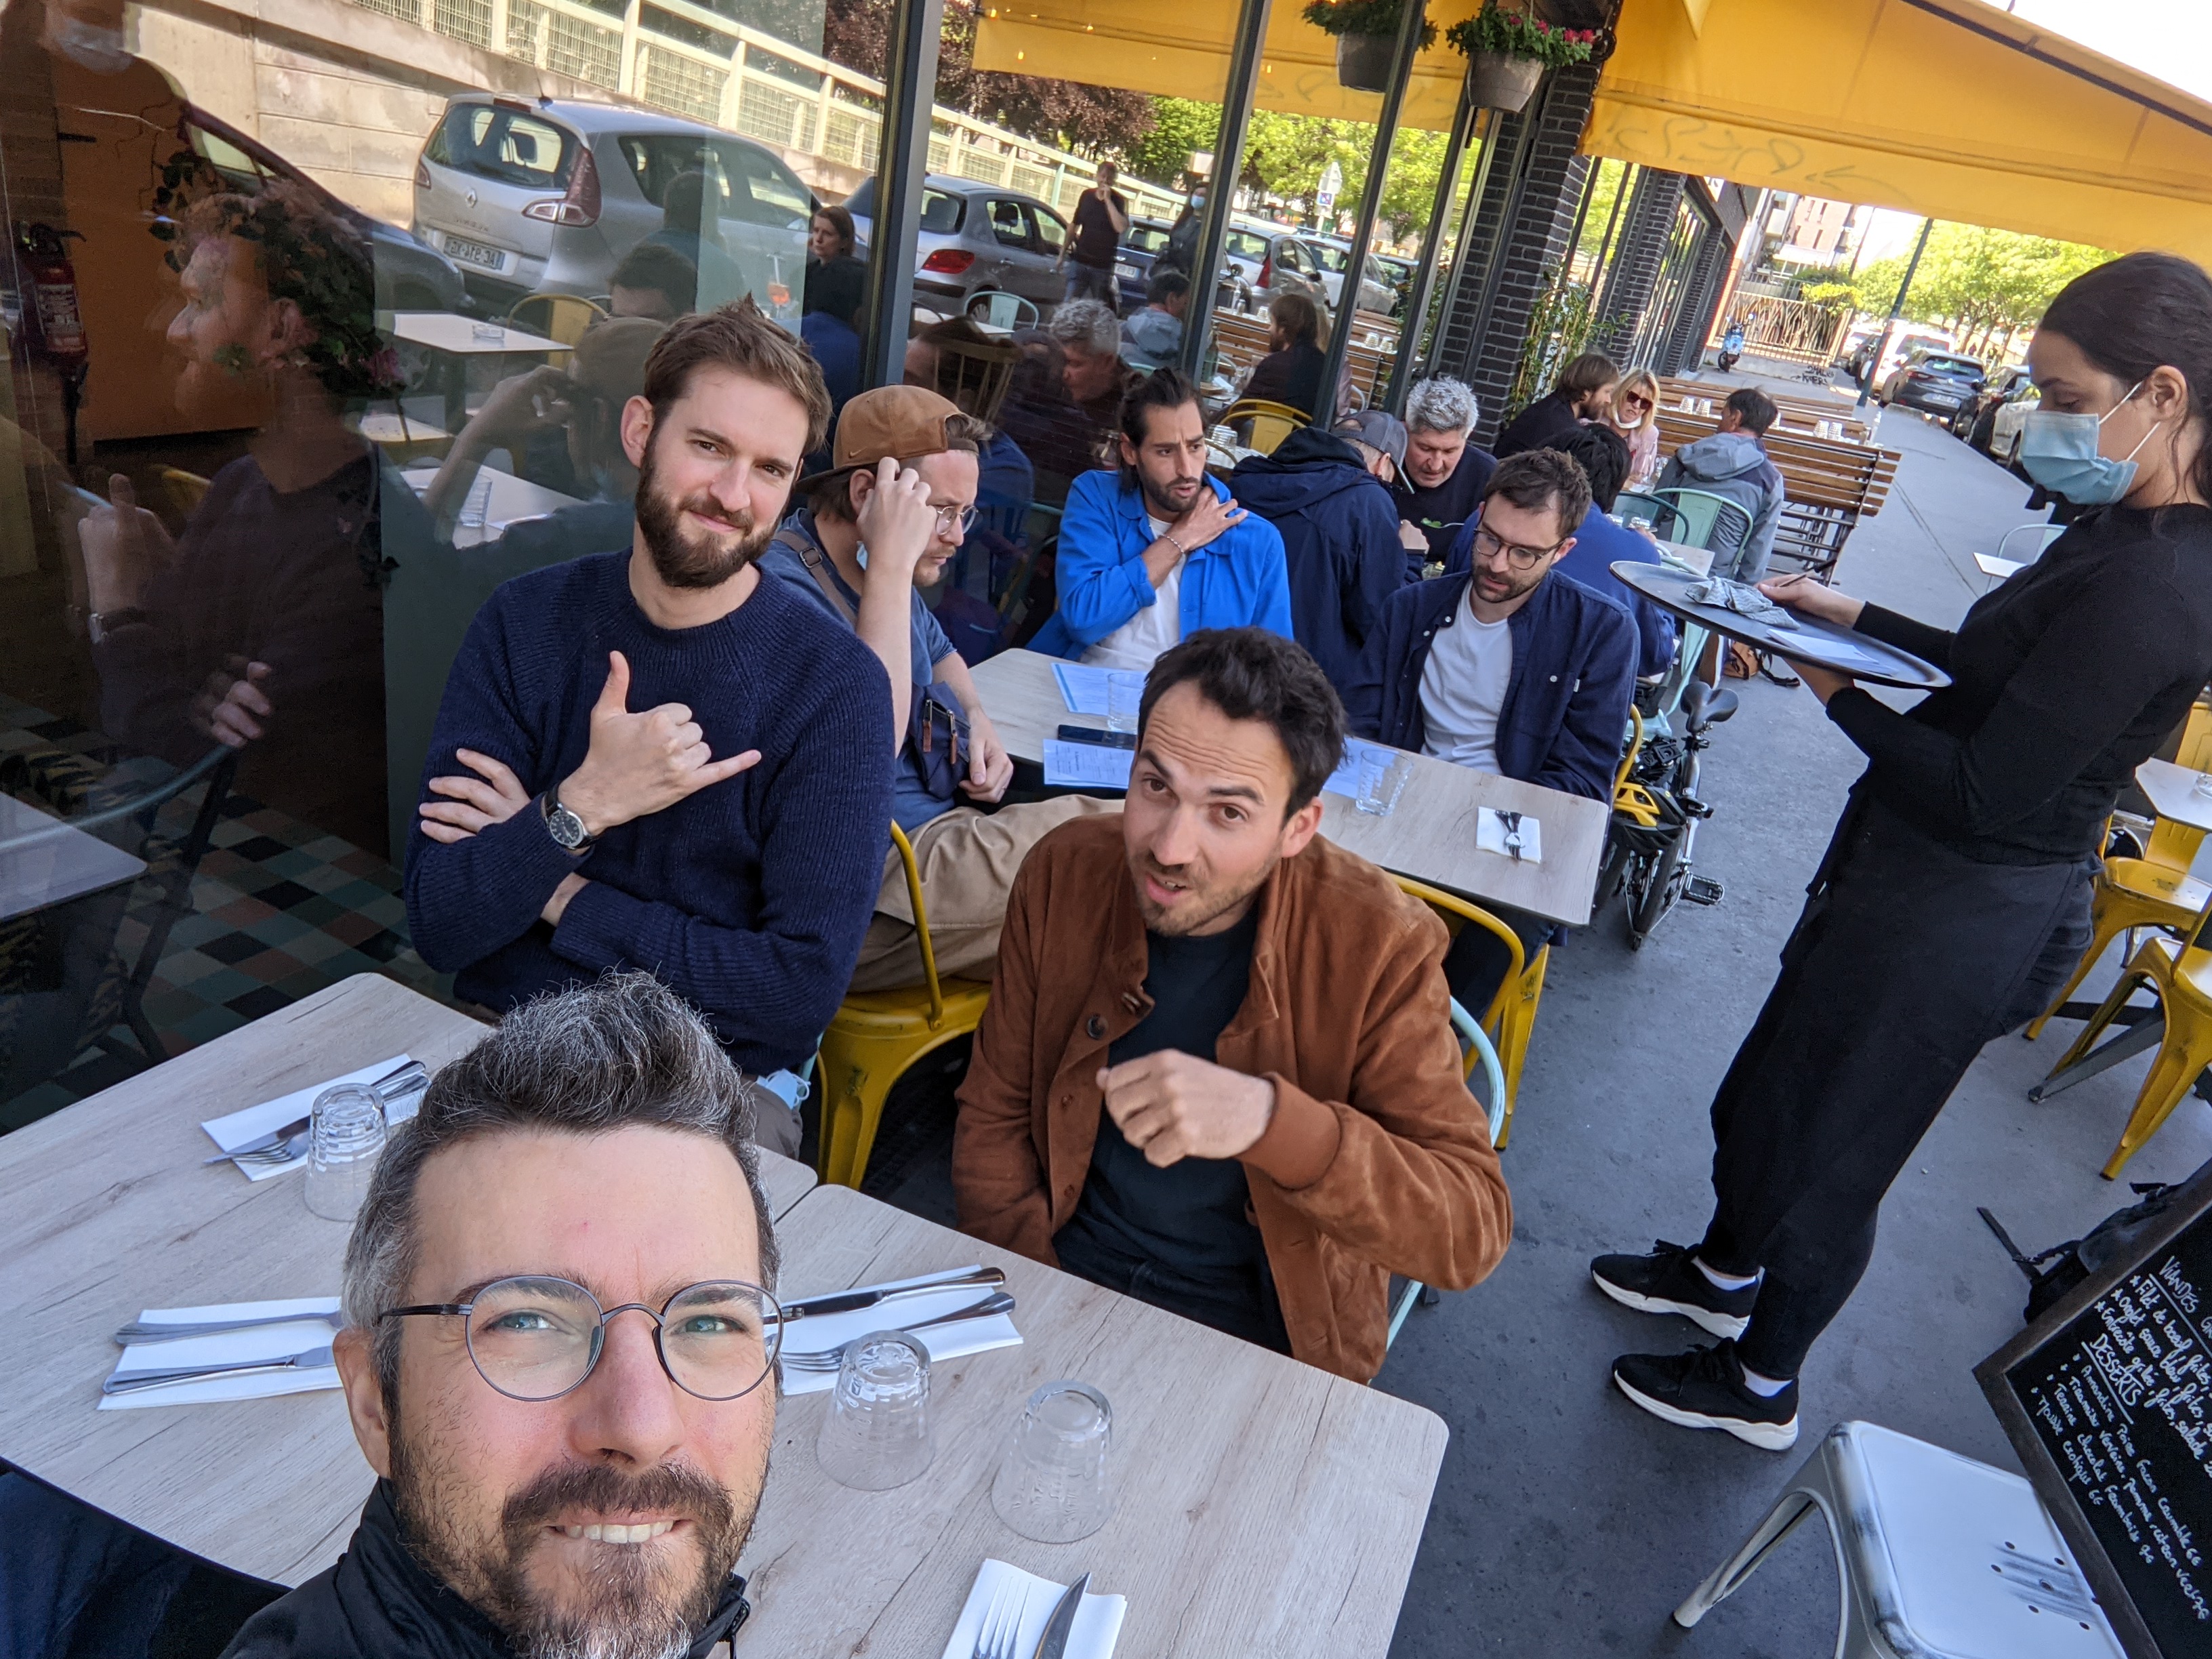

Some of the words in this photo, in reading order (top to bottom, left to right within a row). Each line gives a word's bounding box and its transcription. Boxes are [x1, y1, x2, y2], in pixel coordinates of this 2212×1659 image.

[2152, 1308, 2167, 1324] de
[2138, 1328, 2162, 1358] sauce
[2089, 1333, 2145, 1406] DESSERTS
